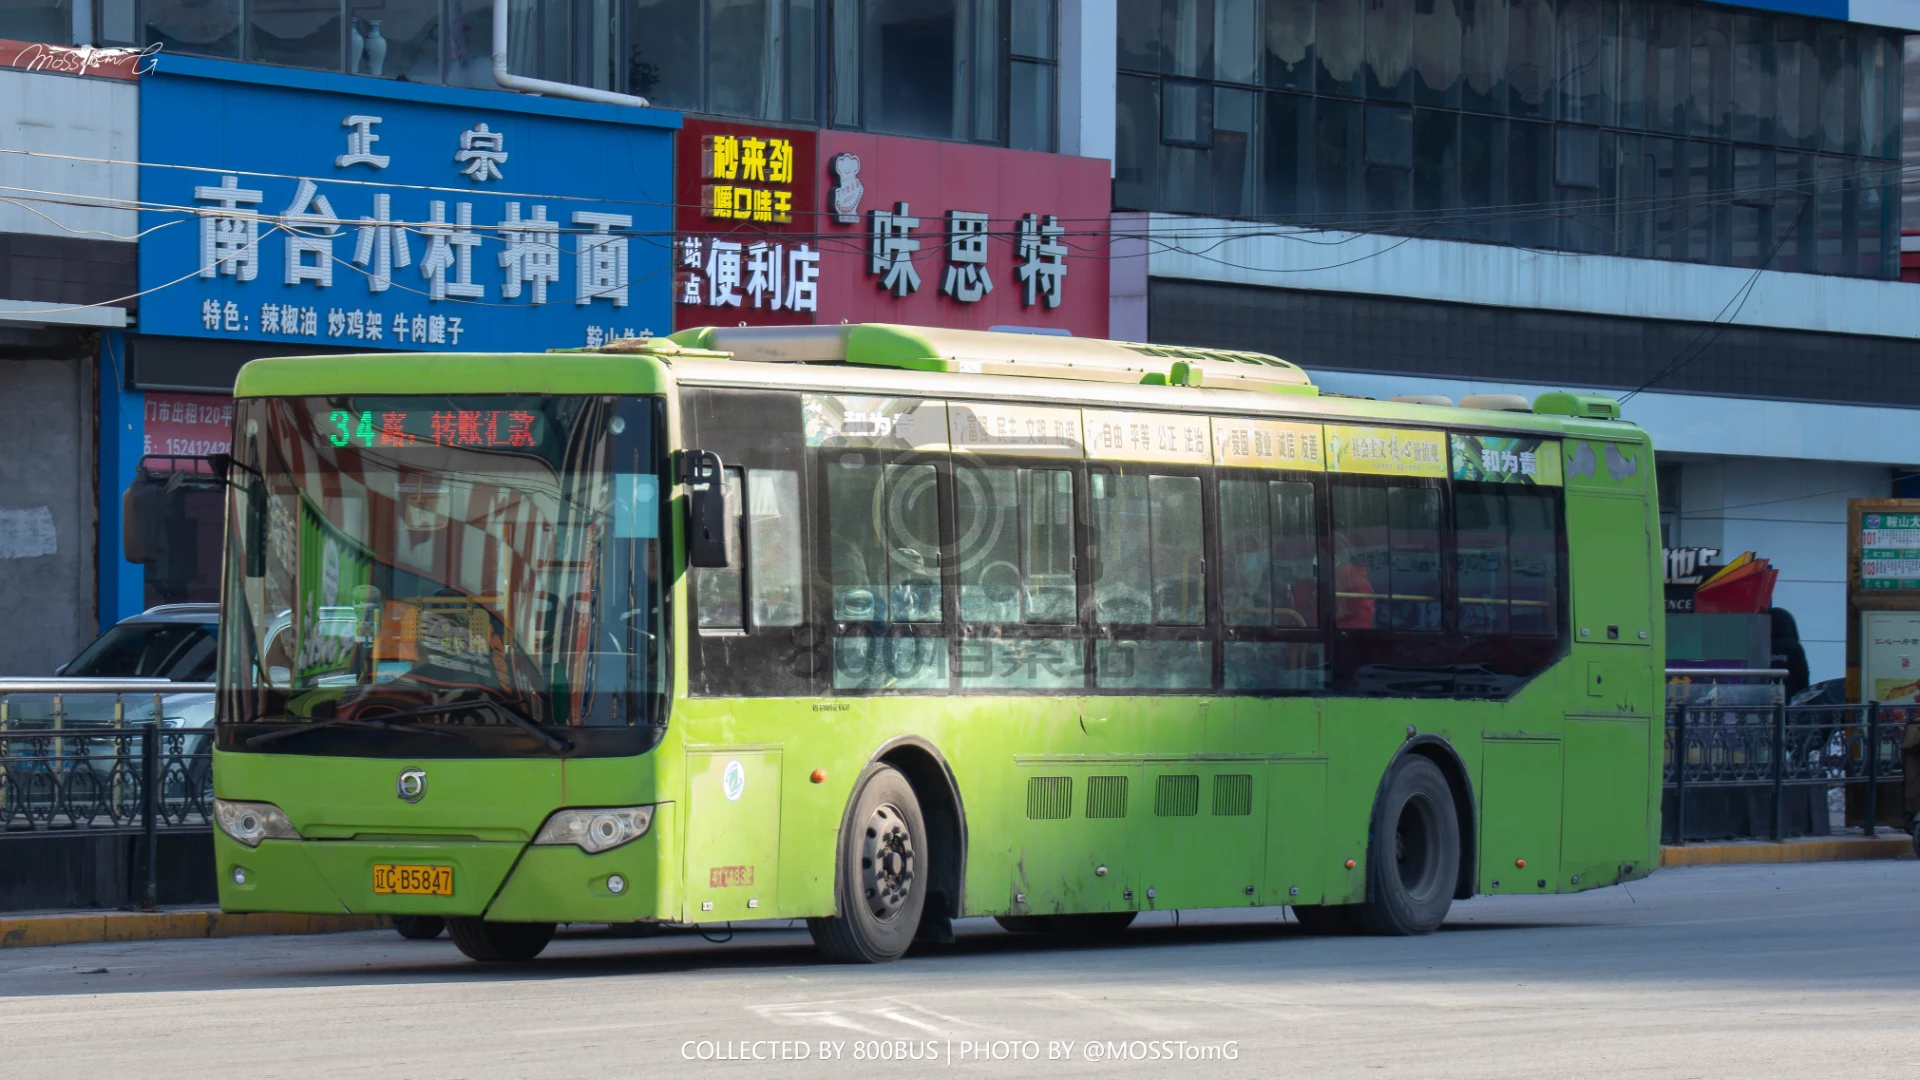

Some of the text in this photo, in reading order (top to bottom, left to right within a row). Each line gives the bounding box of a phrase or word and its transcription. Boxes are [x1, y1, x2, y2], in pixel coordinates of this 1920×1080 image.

[335, 114, 509, 181] 正宗
[712, 135, 794, 183] 秒来劲
[194, 175, 633, 307] 南台小杜抻面
[868, 201, 1069, 309] 味思特
[684, 236, 703, 304] 站点
[706, 237, 821, 312] 便利店
[328, 308, 383, 341] 炒鸡架
[393, 312, 465, 345] 牛肉腱子
[329, 410, 375, 447] 34
[1025, 418, 1047, 445] 文明
[1103, 422, 1204, 453] 自由 平等 公正 法治
[1231, 429, 1318, 460] 爱国 敬业 诚信 友善
[1481, 449, 1537, 475] 和为贵
